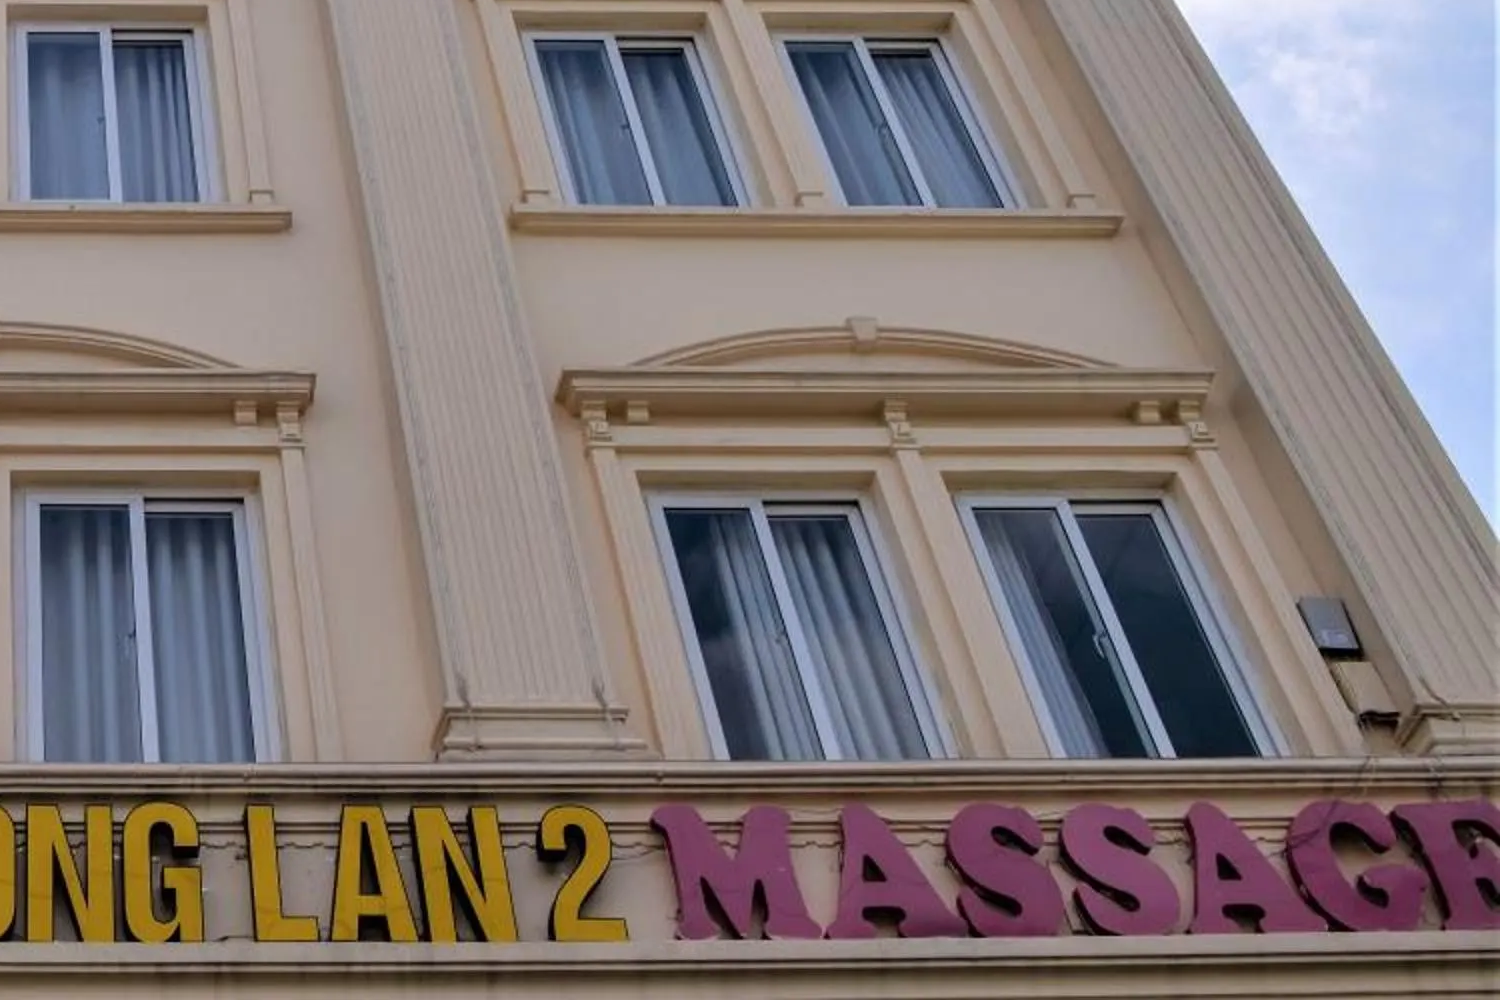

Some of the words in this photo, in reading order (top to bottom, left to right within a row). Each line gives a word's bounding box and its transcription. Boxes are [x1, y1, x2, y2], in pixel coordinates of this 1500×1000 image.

[243, 803, 519, 942] LAN
[537, 804, 629, 941] 2
[650, 799, 1500, 940] MASSAGE
